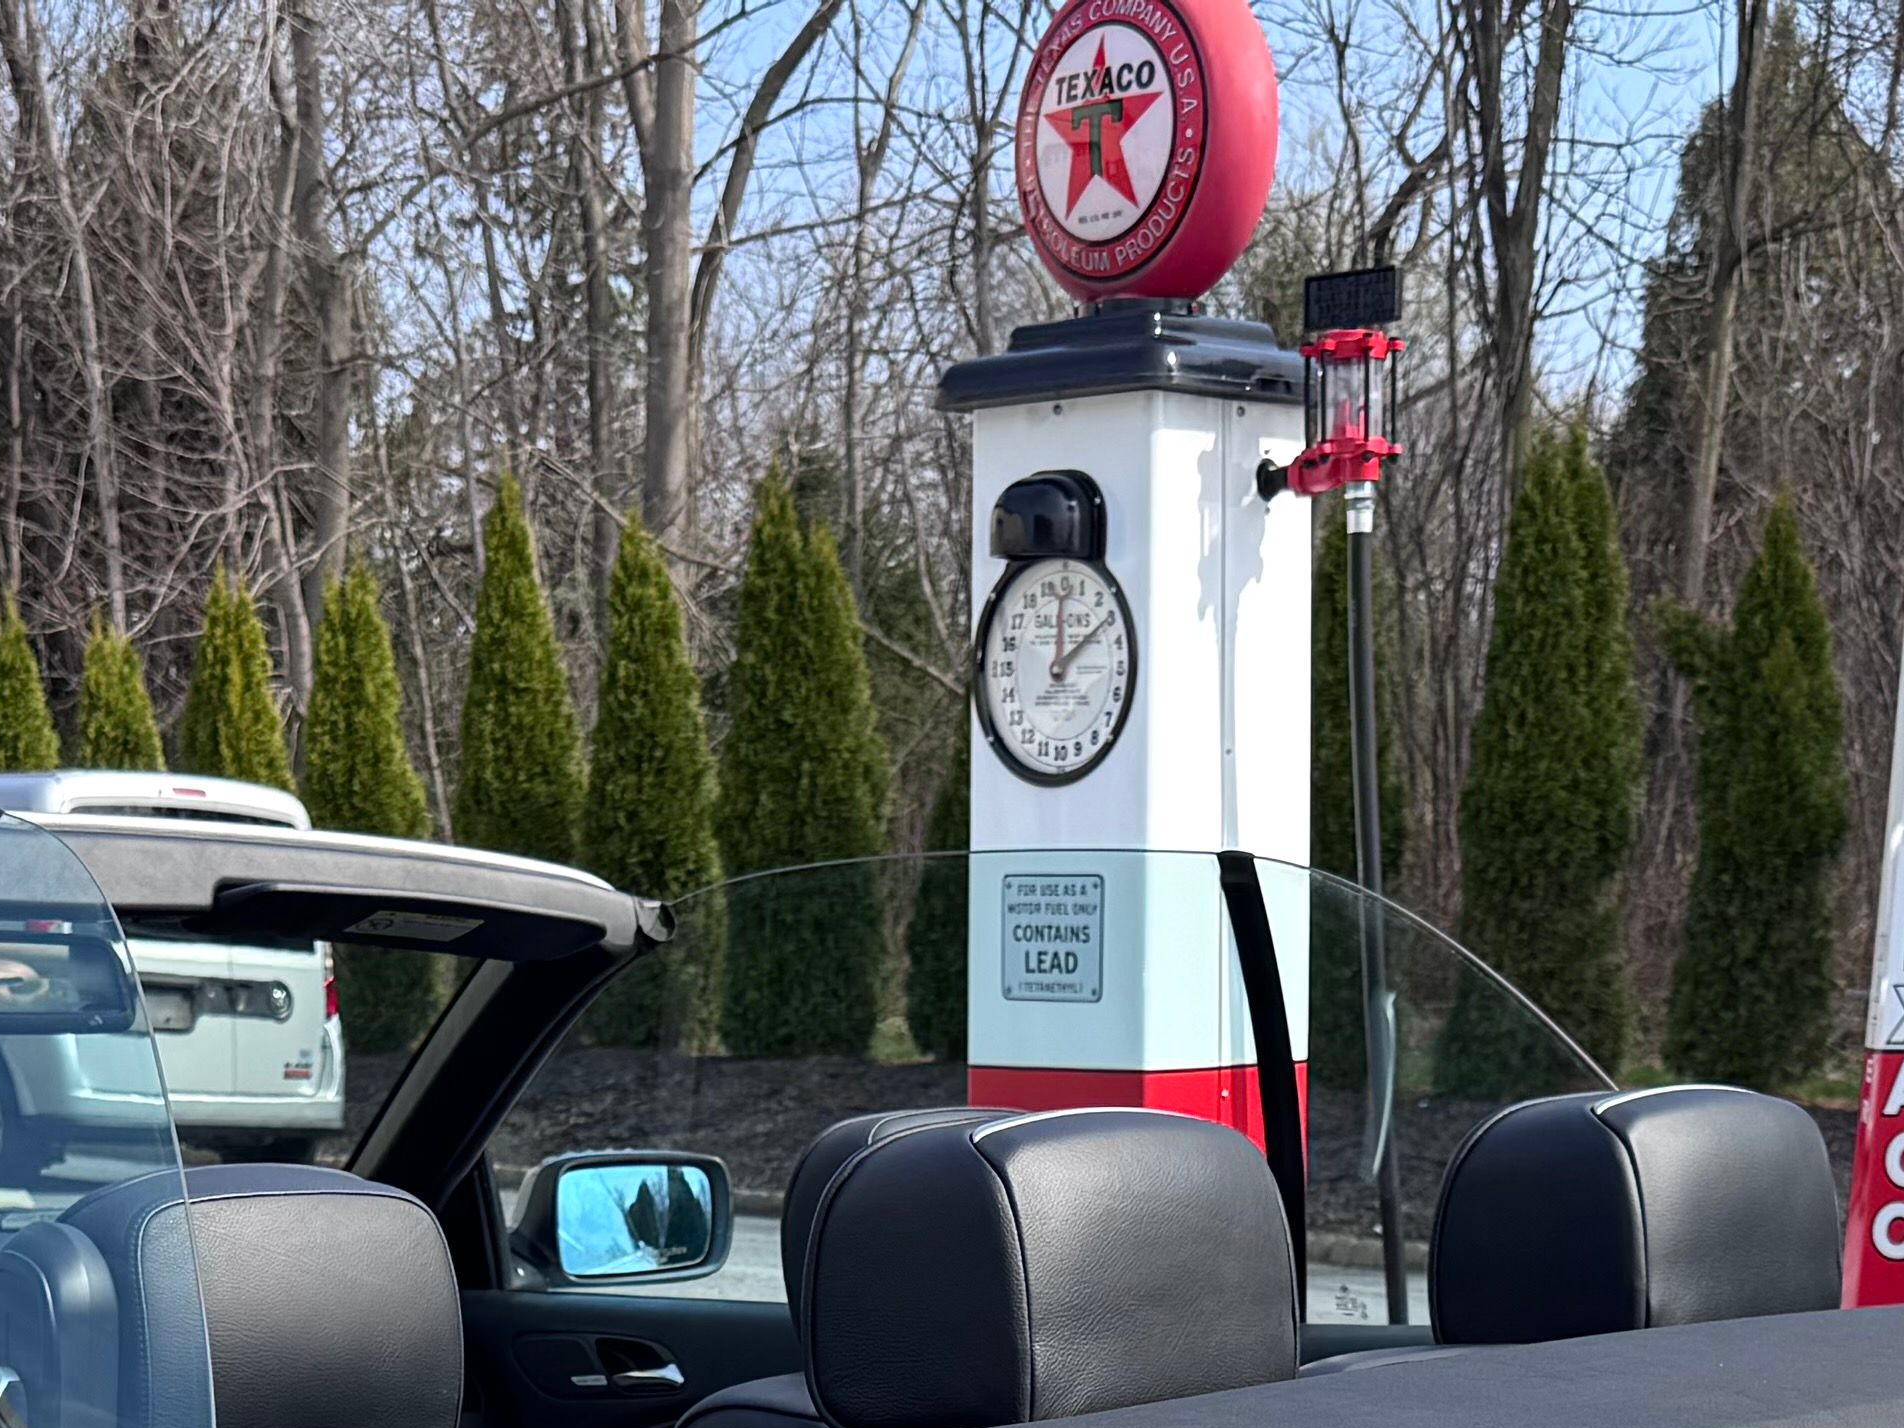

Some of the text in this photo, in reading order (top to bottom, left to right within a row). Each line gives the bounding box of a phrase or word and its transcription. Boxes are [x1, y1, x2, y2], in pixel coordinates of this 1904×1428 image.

[1089, 0, 1176, 42] COMPANY
[1055, 60, 1156, 106] TEXACO
[1114, 146, 1195, 268] PRODUCTS
[1079, 580, 1086, 597] 1
[1094, 591, 1104, 607] 2
[1011, 613, 1025, 630] 17
[1106, 610, 1116, 627] 3
[1002, 636, 1017, 652] 16
[1114, 634, 1123, 650] 4
[1001, 687, 1015, 703] 14
[1113, 686, 1122, 703] 6
[1008, 710, 1024, 726] 13
[1104, 711, 1113, 728] 7
[1020, 729, 1035, 745] 12
[1090, 730, 1099, 746] 8
[1037, 741, 1049, 757] 11
[1053, 745, 1068, 762] 10
[1073, 741, 1083, 757] 9
[1017, 884, 1087, 897] FOR USE AS A
[1044, 903, 1069, 916] FUEL
[1012, 924, 1091, 944] CONTAINS
[1024, 950, 1079, 974] LEAD
